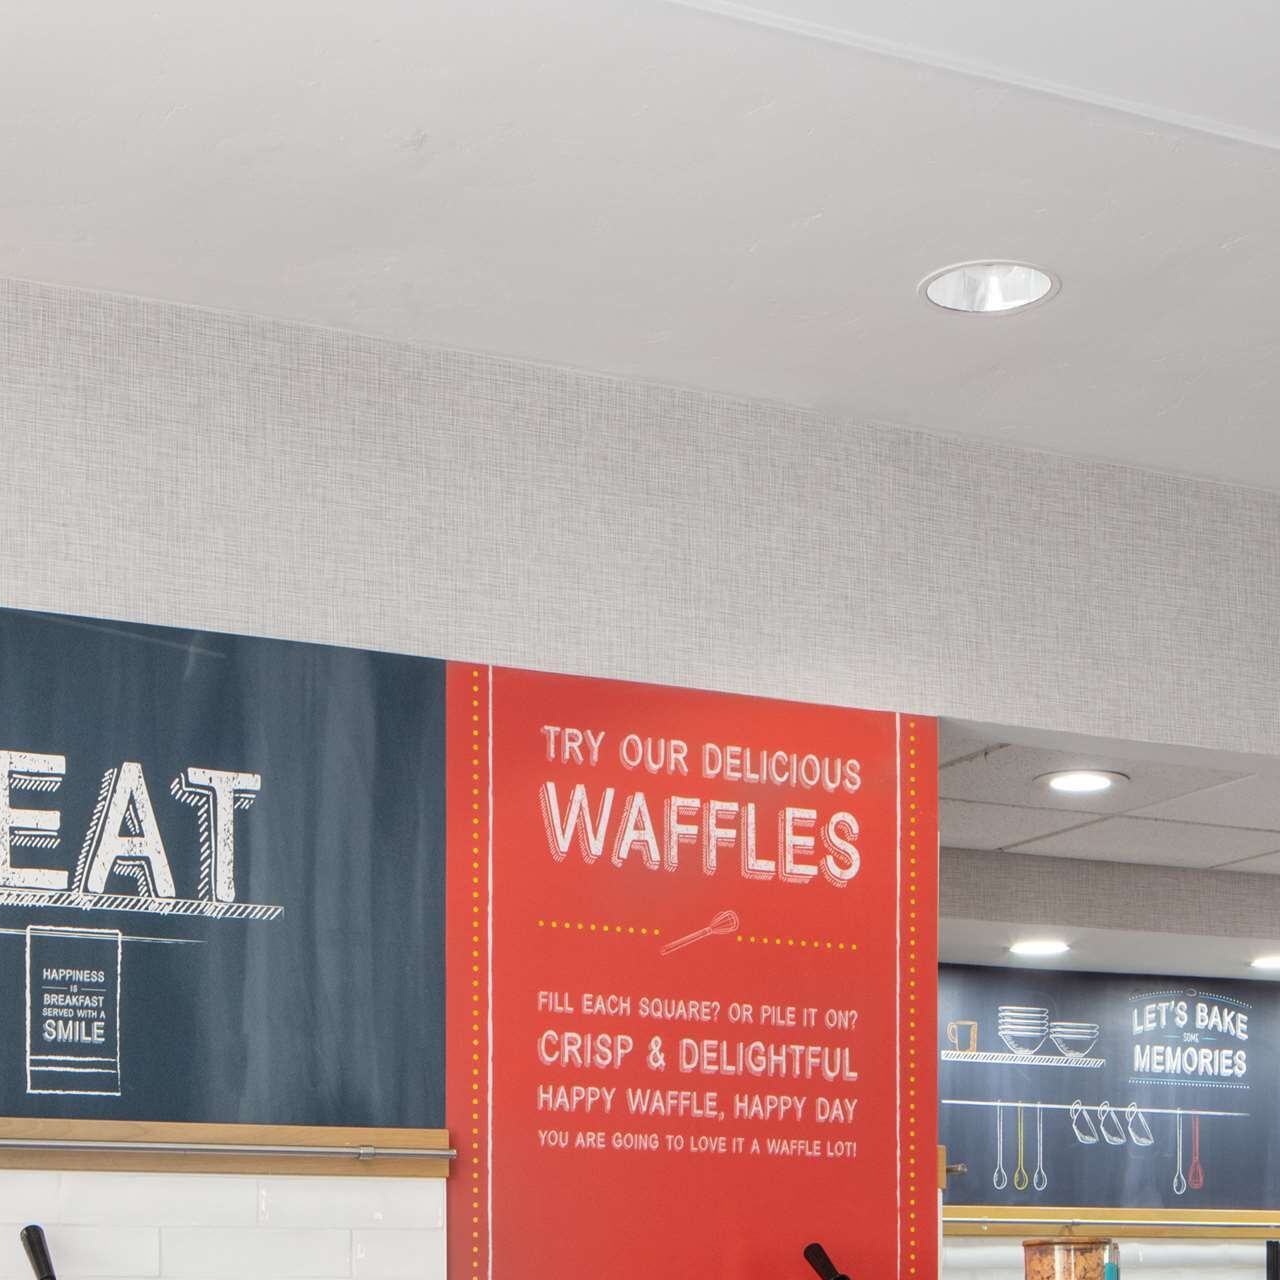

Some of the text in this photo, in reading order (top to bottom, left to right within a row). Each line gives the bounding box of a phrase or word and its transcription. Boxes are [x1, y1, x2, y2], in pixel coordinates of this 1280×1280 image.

[541, 724, 862, 794] TRY OUR DELICIOUS
[539, 781, 861, 887] WAFFLES
[42, 968, 104, 982] HAPPINESS
[42, 1008, 106, 1019] SERVED WITH A
[43, 994, 104, 1007] BREAKFAST
[537, 991, 858, 1029] FILL EACH SQUARE? OR PILE IT ON?
[42, 1019, 105, 1043] SMILE
[1132, 1000, 1248, 1040] LET'S BAKE
[538, 1030, 858, 1081] CRISP & DELIGHTFUL
[1134, 1044, 1246, 1077] MEMORIES
[538, 1084, 857, 1123] HAPPY WAFFLE, HAPPY DAY
[538, 1130, 857, 1157] YOU ARE GOING TO LOVE IT A WAFFLE LOT!
